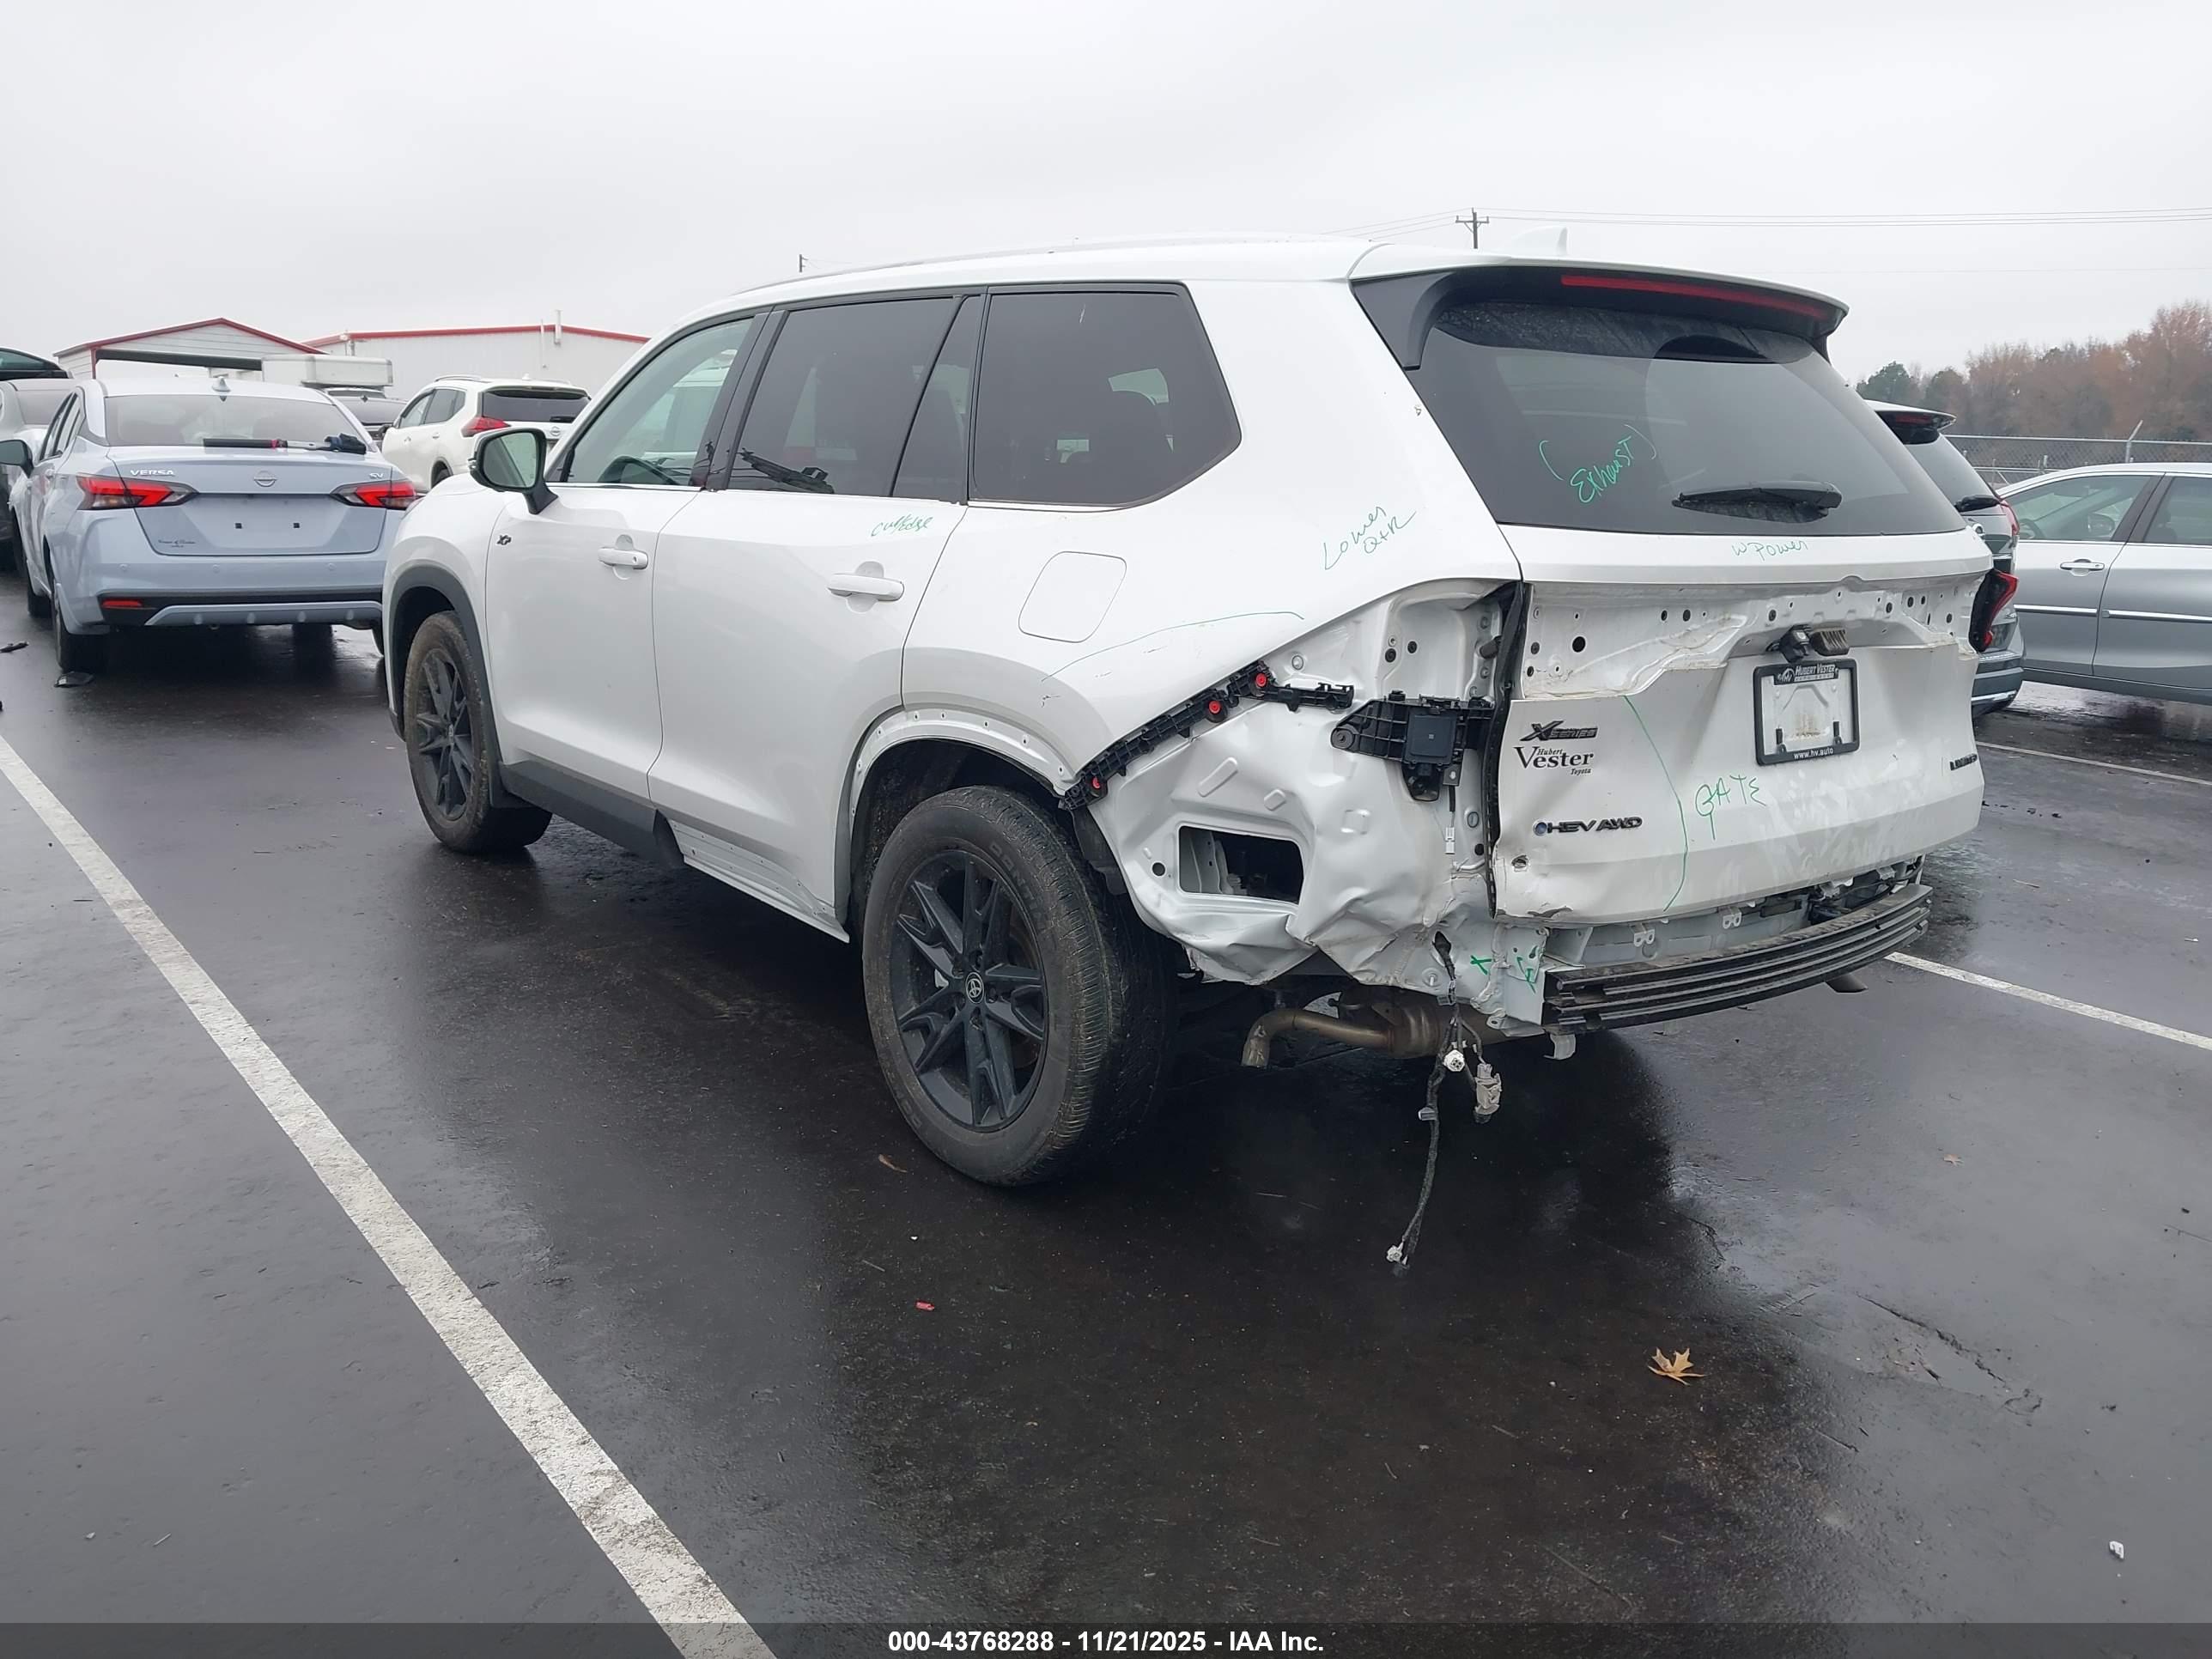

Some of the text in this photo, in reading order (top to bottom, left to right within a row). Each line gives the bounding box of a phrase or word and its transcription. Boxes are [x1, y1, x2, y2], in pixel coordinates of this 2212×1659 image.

[1513, 745, 1594, 769] Vester
[1794, 746, 1833, 759] www.hv.auto
[1571, 768, 1591, 776] Toyota
[1595, 817, 1643, 831] AWD
